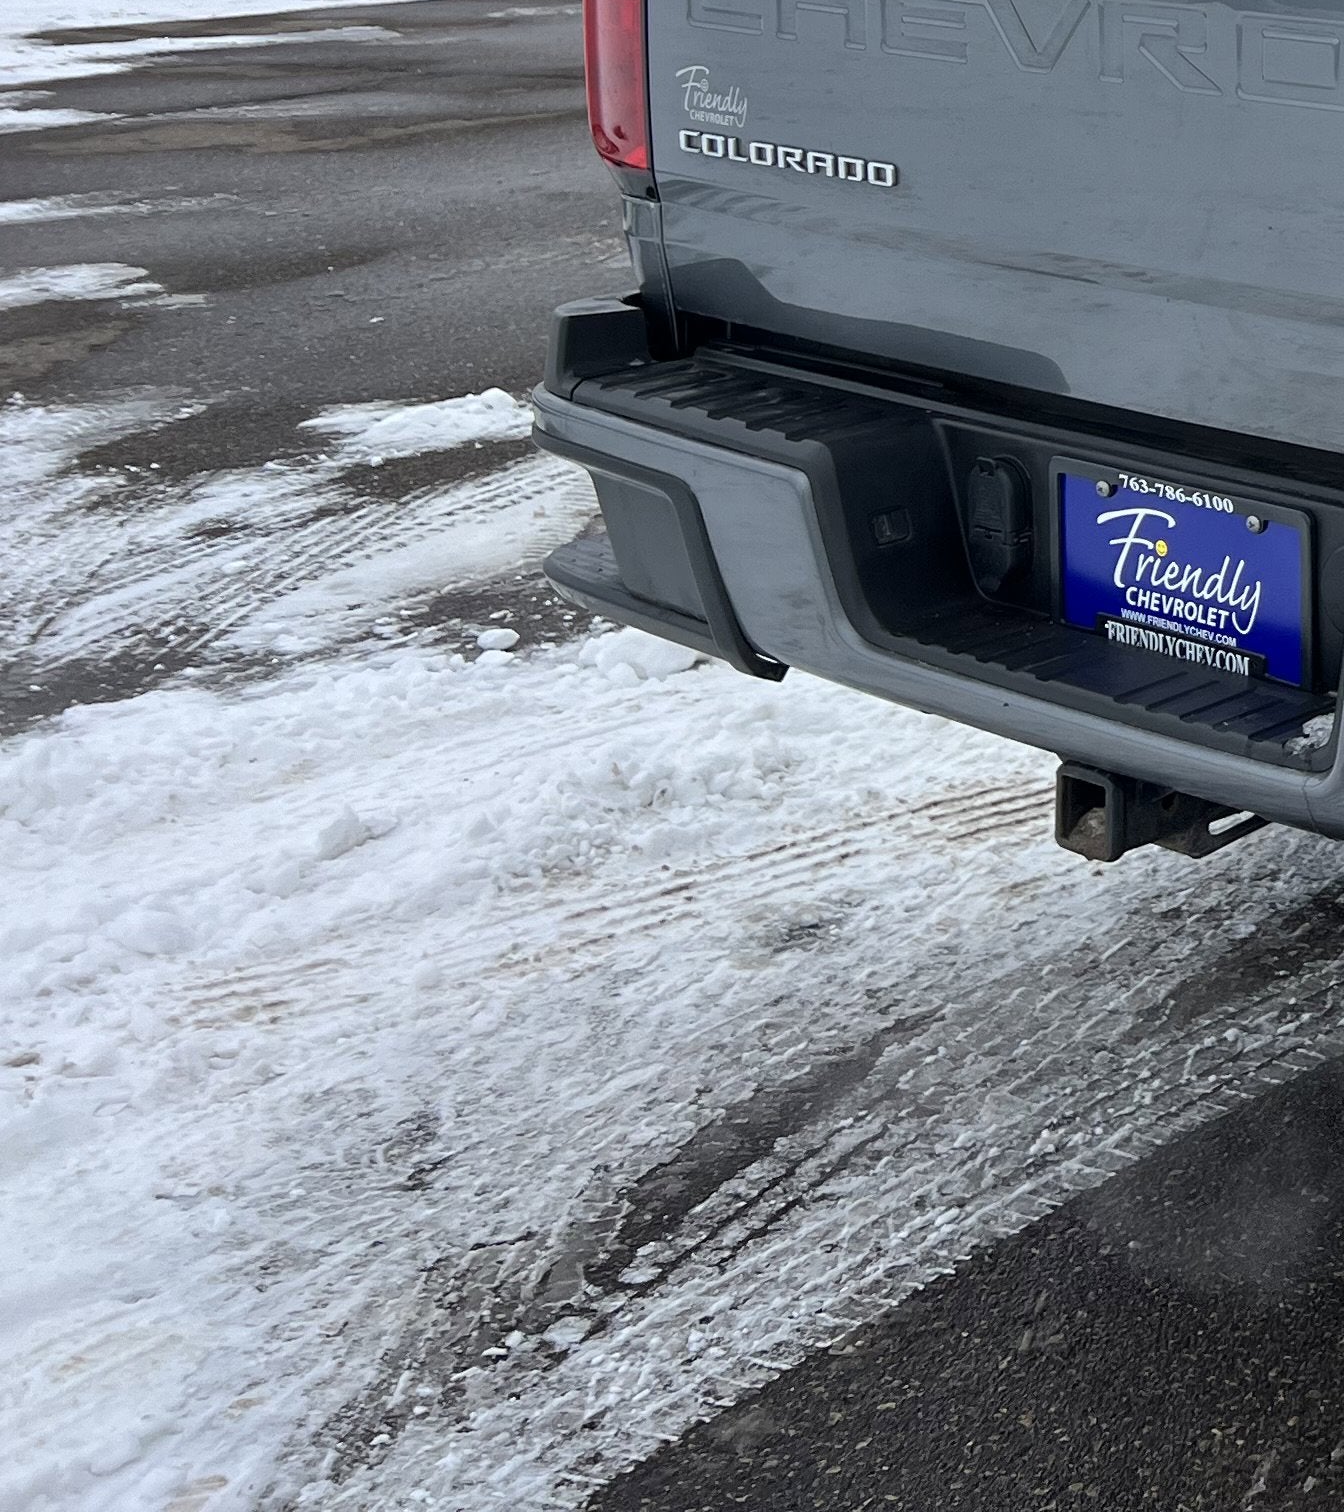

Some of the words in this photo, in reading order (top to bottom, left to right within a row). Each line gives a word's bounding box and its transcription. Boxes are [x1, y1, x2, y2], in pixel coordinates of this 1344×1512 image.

[675, 65, 748, 128] Friendly
[689, 109, 734, 127] CHEVROLET
[679, 129, 898, 188] COLORADO
[1118, 473, 1234, 514] 763-786-6100
[1096, 507, 1261, 635] Friendly
[1120, 607, 1237, 648] WWW.FRIENDLYCHEV.COM
[1126, 586, 1229, 629] CHEVROLET
[1105, 619, 1250, 676] FRIENDLYCHEV.COM
